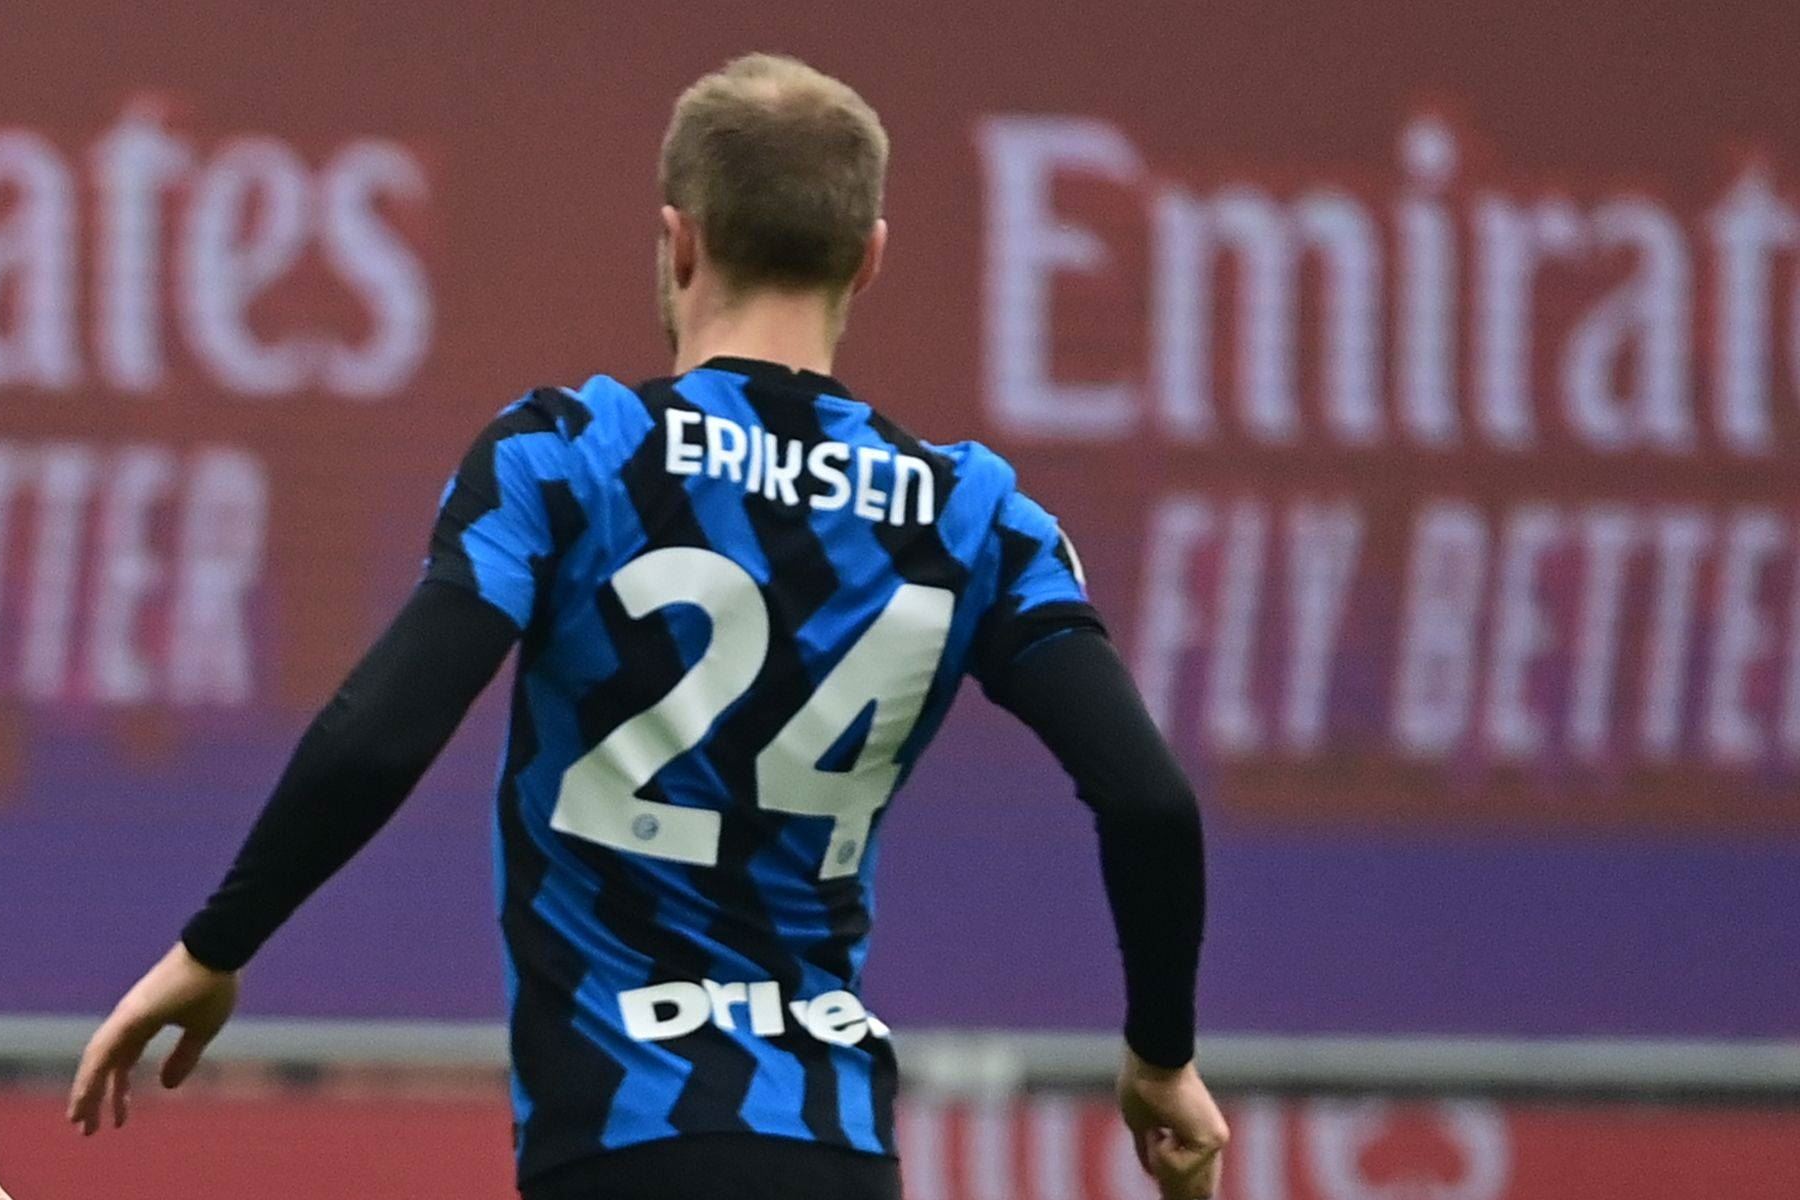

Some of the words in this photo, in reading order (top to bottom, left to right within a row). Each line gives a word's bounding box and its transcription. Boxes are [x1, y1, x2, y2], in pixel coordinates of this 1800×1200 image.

[978, 112, 1800, 452] Emirat
[664, 407, 934, 526] ERIKSEN
[550, 546, 955, 881] 24
[1398, 500, 1800, 765] BETTE
